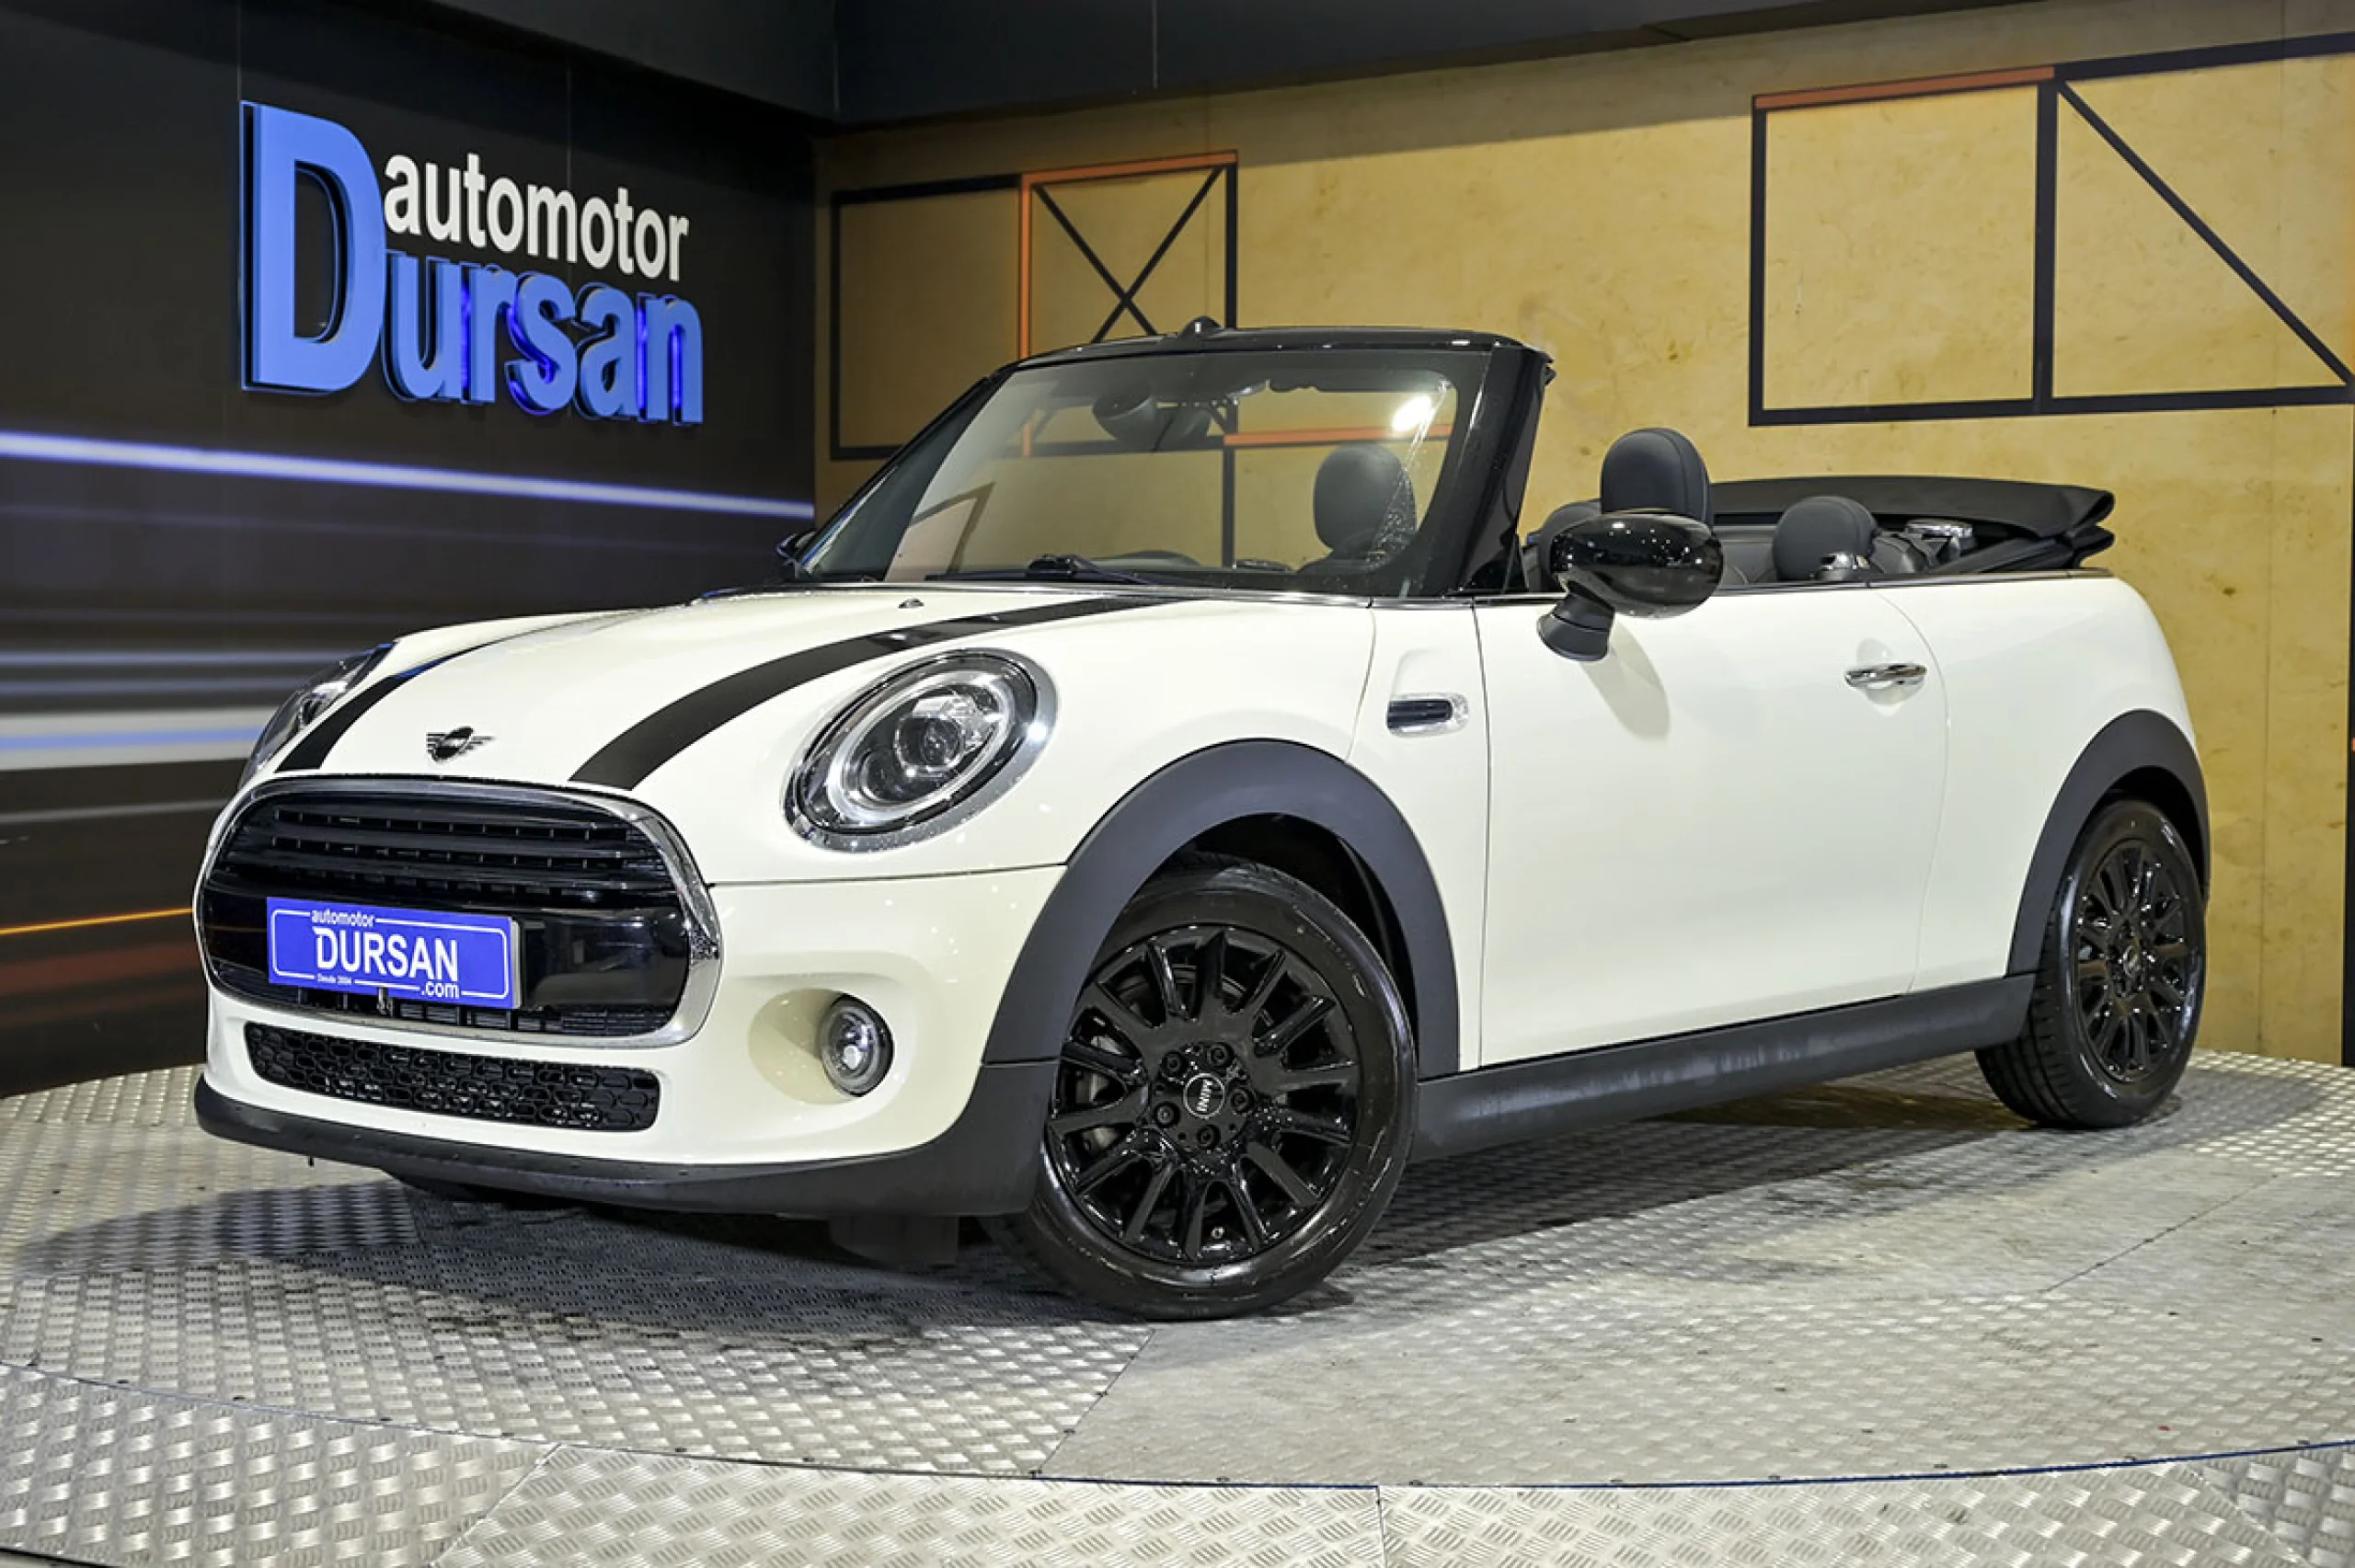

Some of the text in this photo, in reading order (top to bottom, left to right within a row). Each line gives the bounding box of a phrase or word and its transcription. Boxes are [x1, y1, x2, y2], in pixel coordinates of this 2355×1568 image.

[384, 153, 689, 280] automotor
[240, 100, 703, 424] Dursan
[311, 909, 375, 927] automotor
[312, 926, 458, 981] DURSAN
[421, 981, 460, 999] .com
